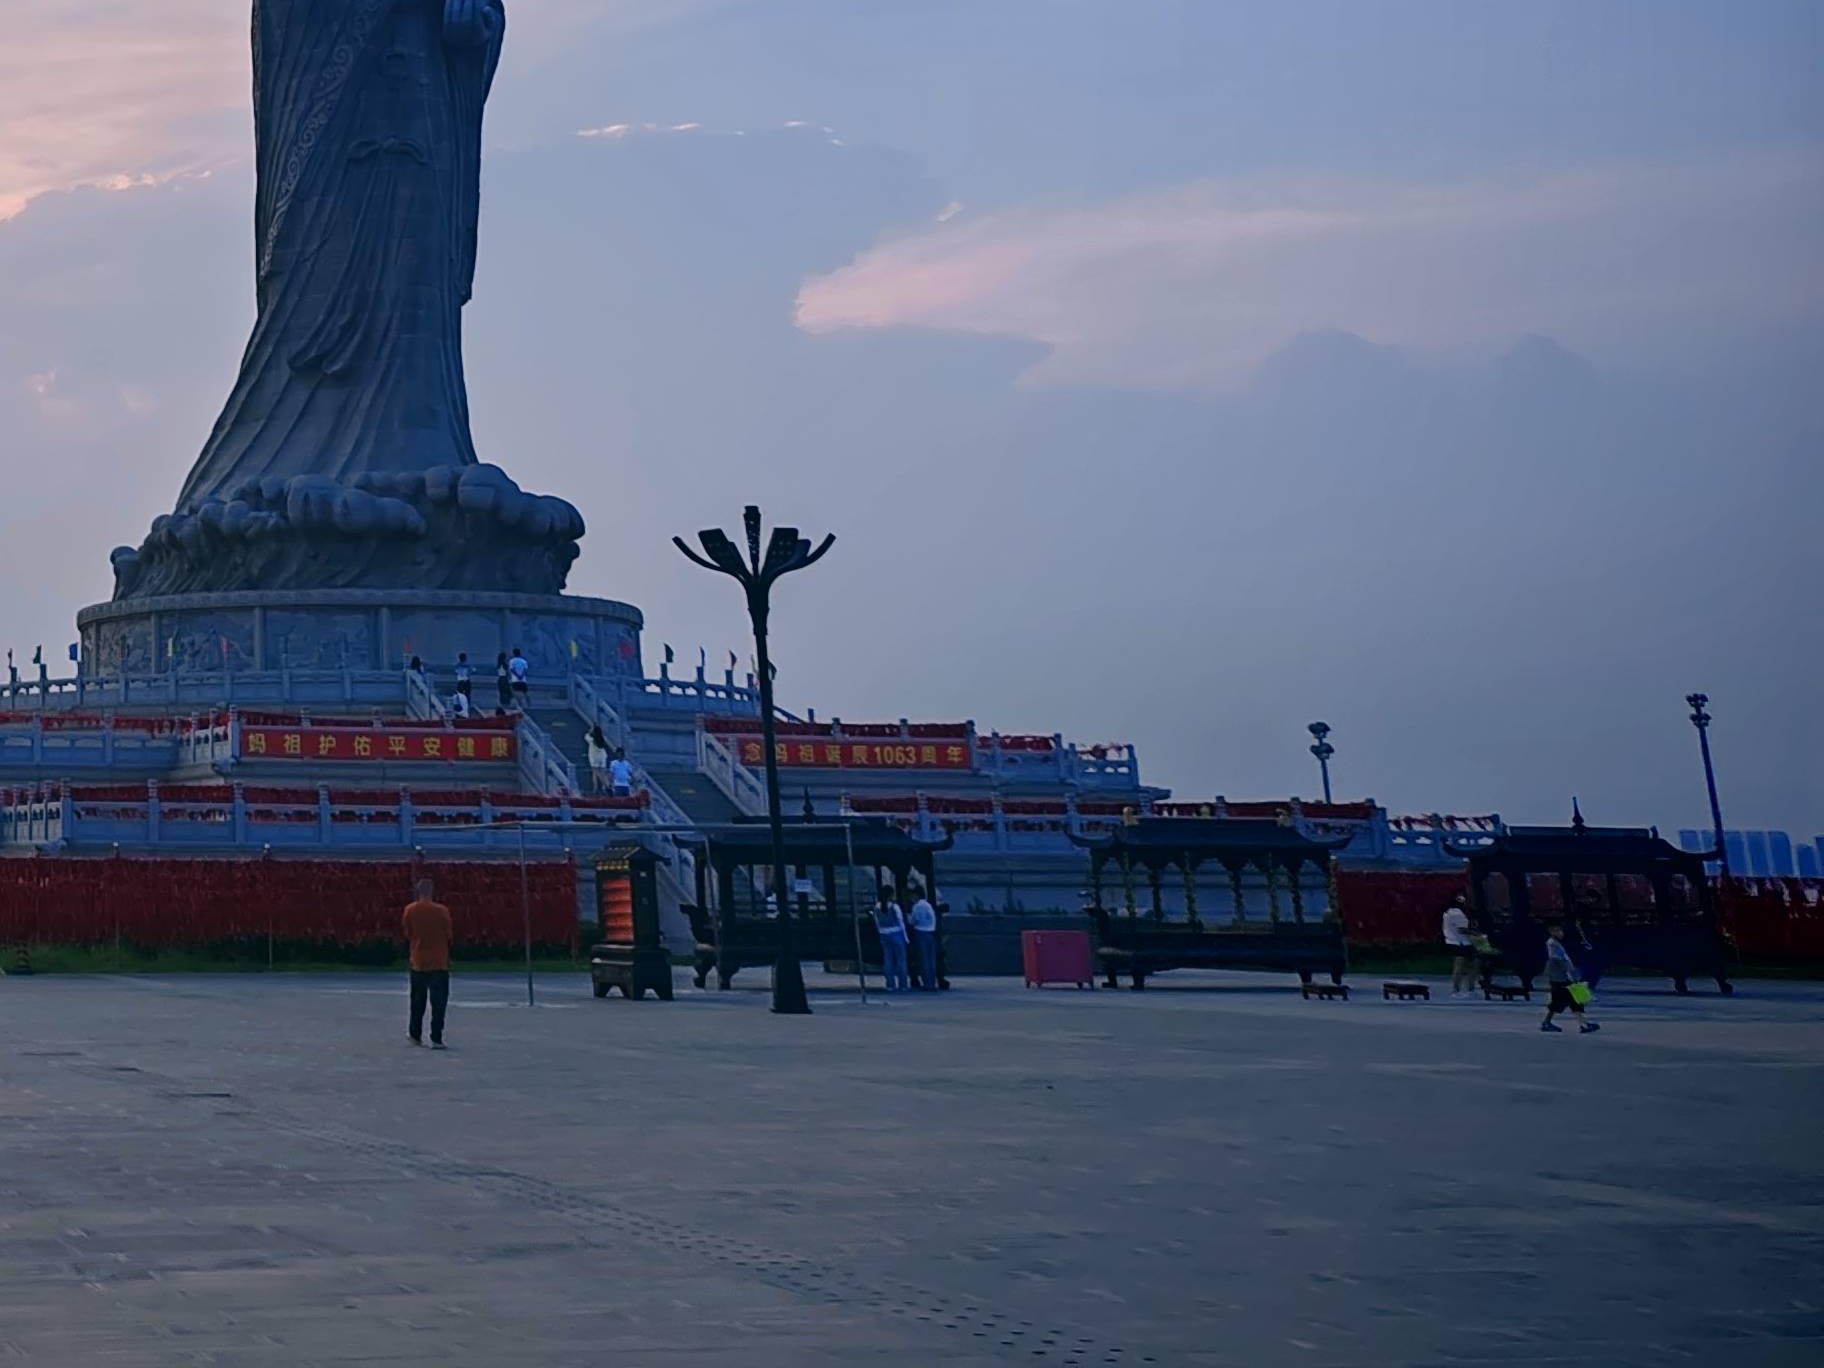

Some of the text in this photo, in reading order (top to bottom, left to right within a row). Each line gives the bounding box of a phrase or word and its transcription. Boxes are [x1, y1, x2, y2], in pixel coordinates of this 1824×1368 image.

[248, 732, 509, 757] 妈祖护佑平安健康
